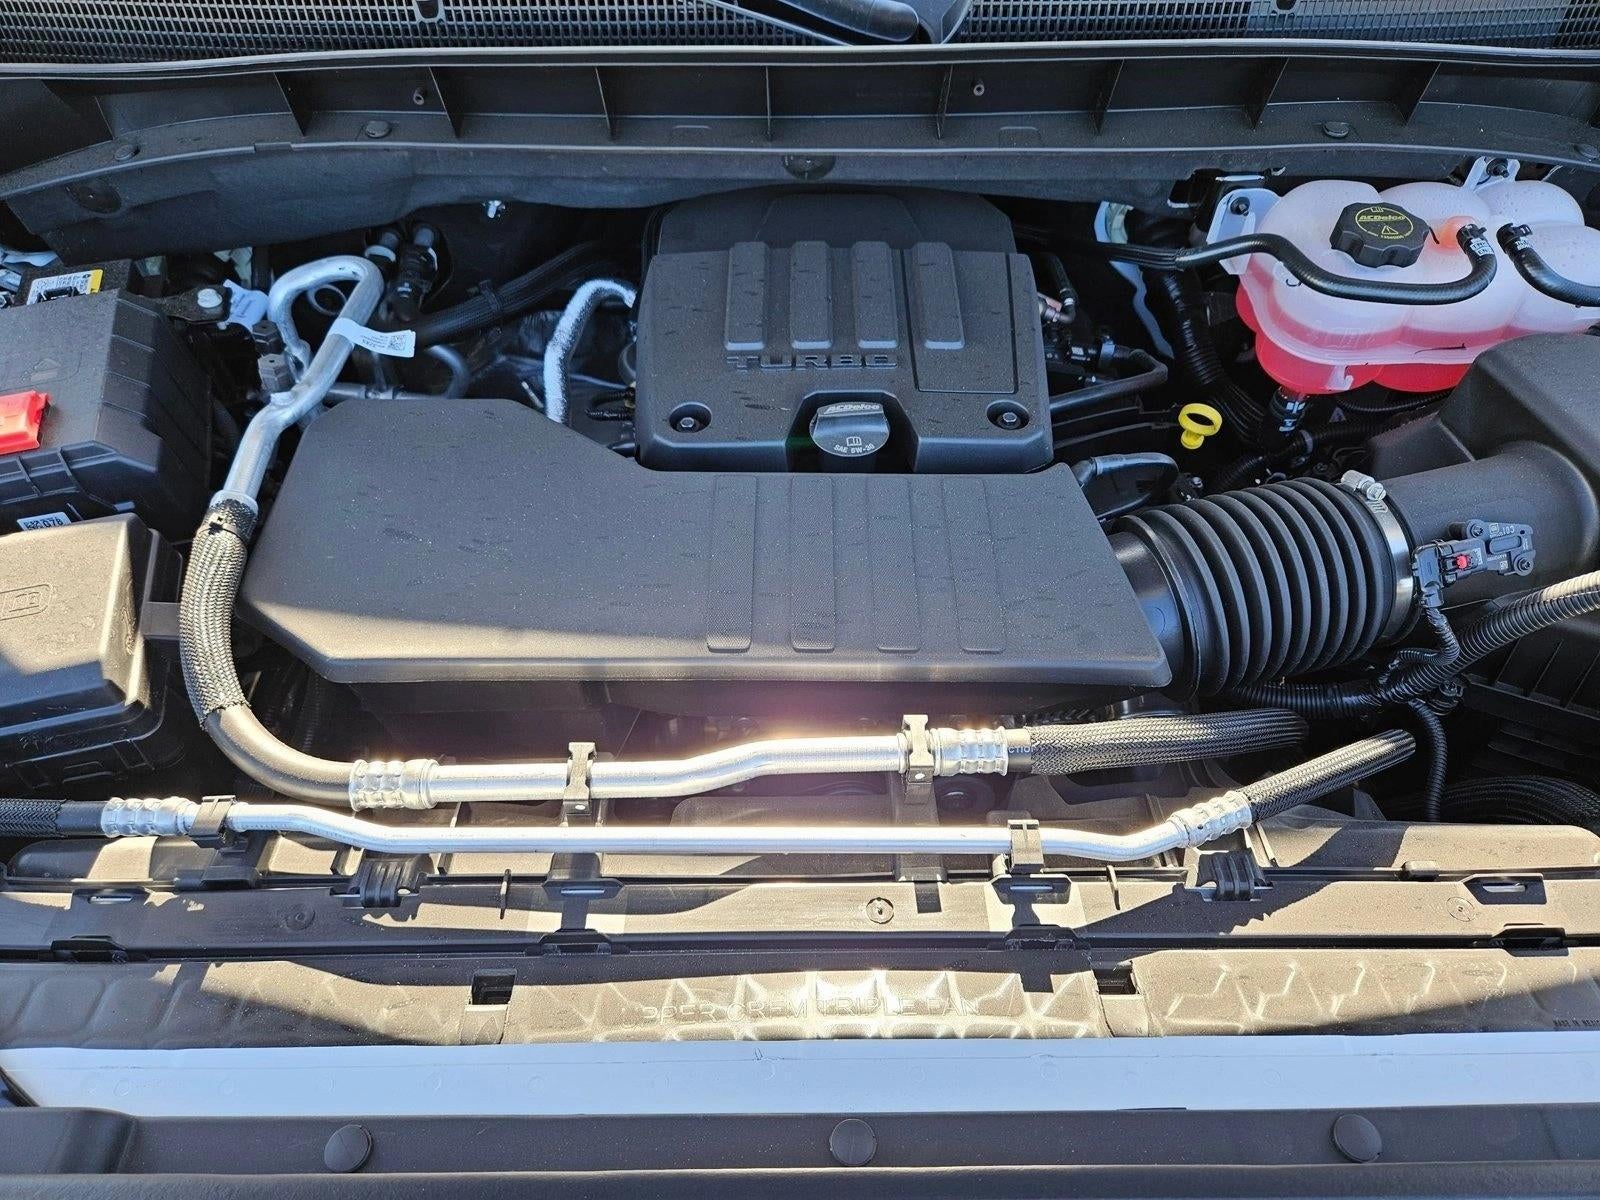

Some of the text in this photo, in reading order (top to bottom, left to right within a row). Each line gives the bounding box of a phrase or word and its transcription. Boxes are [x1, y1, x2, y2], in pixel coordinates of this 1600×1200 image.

[1358, 214, 1405, 222] ACDelco
[726, 354, 897, 371] TURBO
[824, 403, 880, 414] ACDelco
[833, 444, 848, 454] SAE
